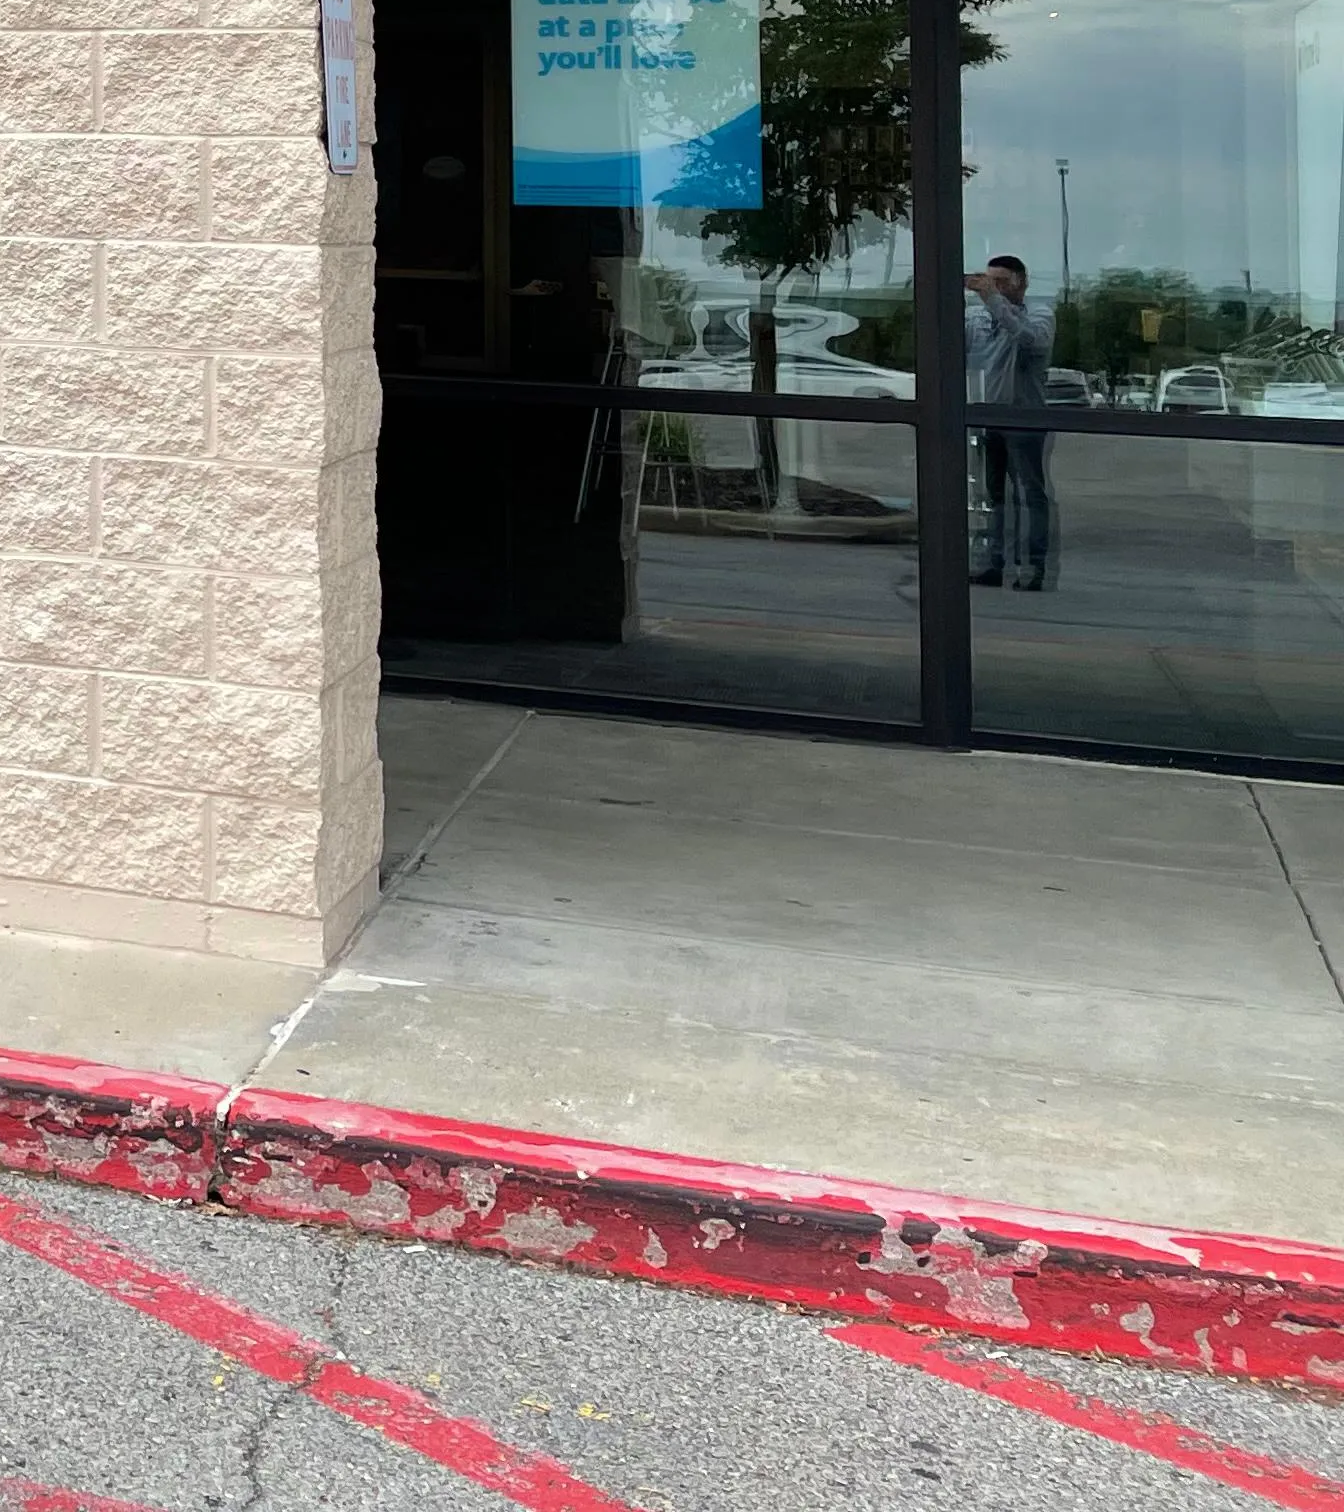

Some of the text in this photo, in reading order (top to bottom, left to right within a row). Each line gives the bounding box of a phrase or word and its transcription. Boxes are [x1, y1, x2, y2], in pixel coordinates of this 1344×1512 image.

[538, 16, 570, 38] at
[579, 19, 596, 38] a
[538, 45, 622, 77] you'll
